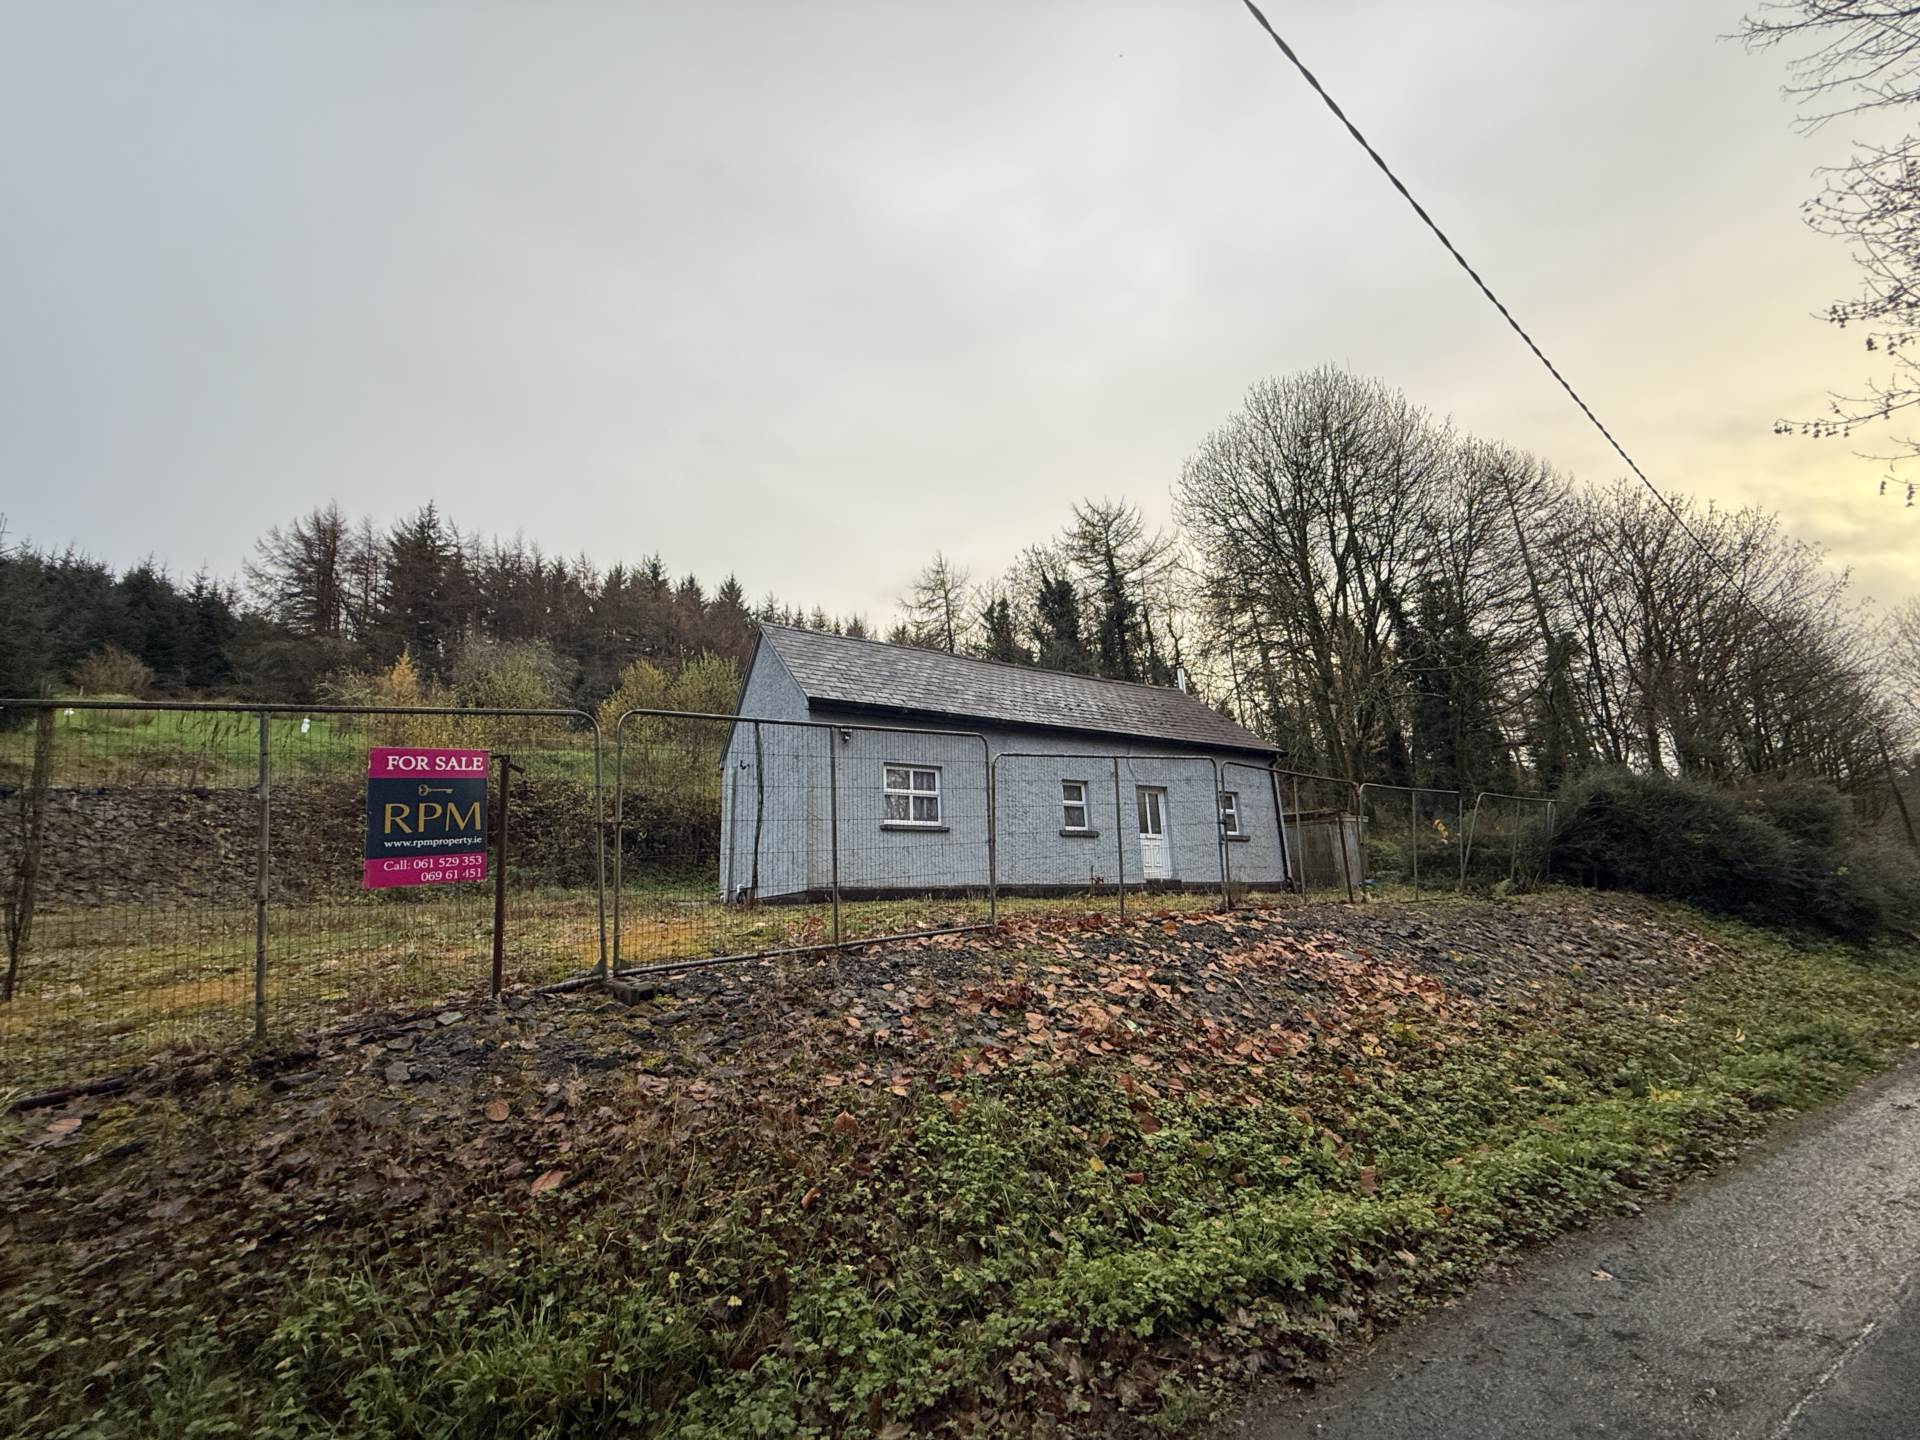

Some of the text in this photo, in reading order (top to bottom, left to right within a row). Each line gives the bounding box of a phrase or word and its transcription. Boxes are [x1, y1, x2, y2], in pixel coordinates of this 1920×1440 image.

[386, 755, 483, 771] FOR SALE
[384, 802, 481, 834] RPM
[384, 836, 482, 849] www.rpmproperty.ie
[383, 855, 482, 871] Call: 061 529 353
[420, 871, 443, 882] 069
[445, 869, 458, 880] 61
